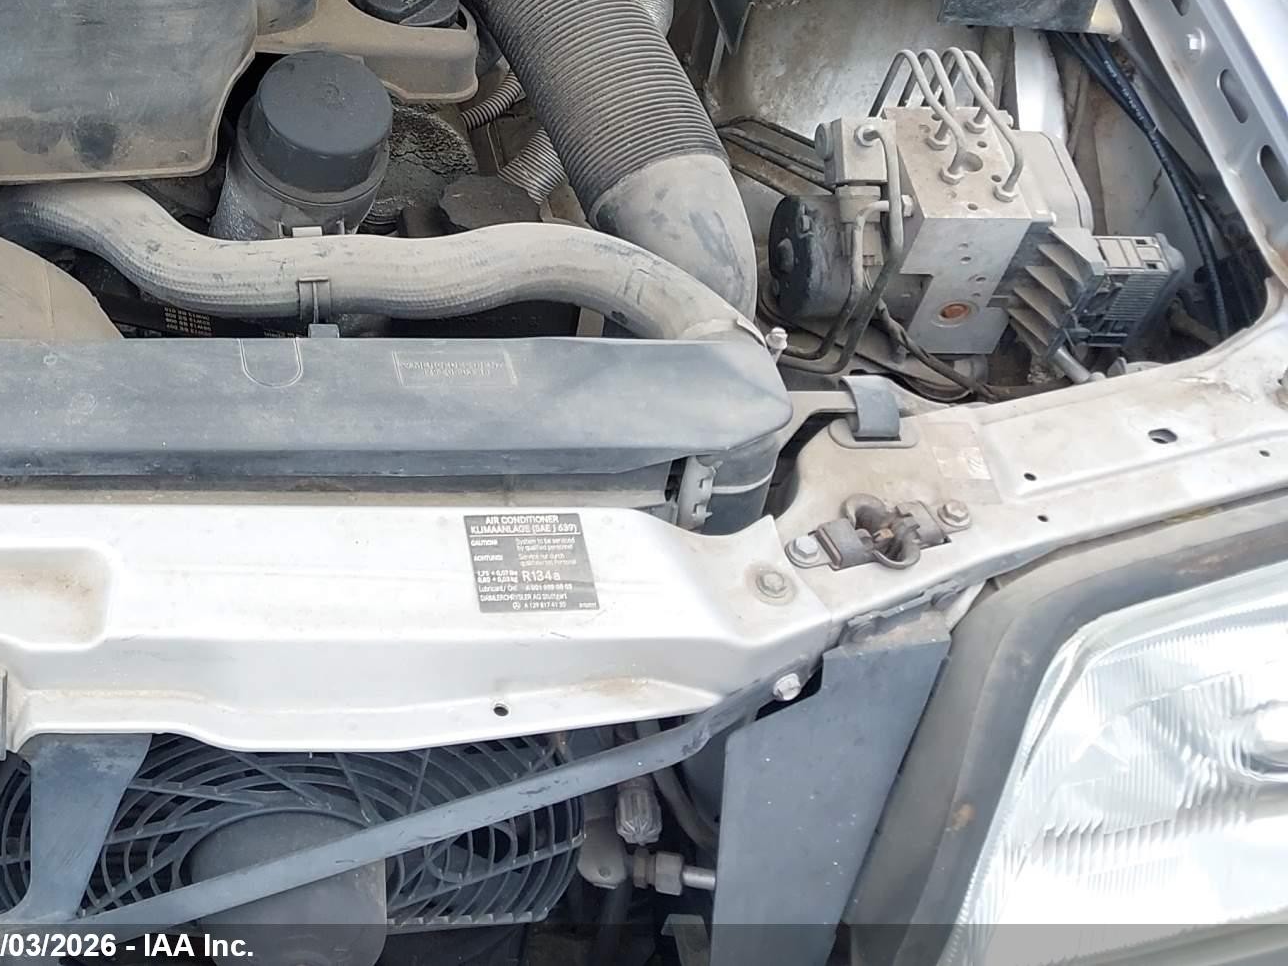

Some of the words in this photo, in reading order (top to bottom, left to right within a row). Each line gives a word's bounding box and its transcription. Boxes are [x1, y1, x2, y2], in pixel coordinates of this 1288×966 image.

[485, 516, 500, 524] AIR
[500, 514, 559, 524] CONDITIONER
[470, 524, 531, 534] KLIMAANLAGE
[532, 524, 551, 534] (SAE
